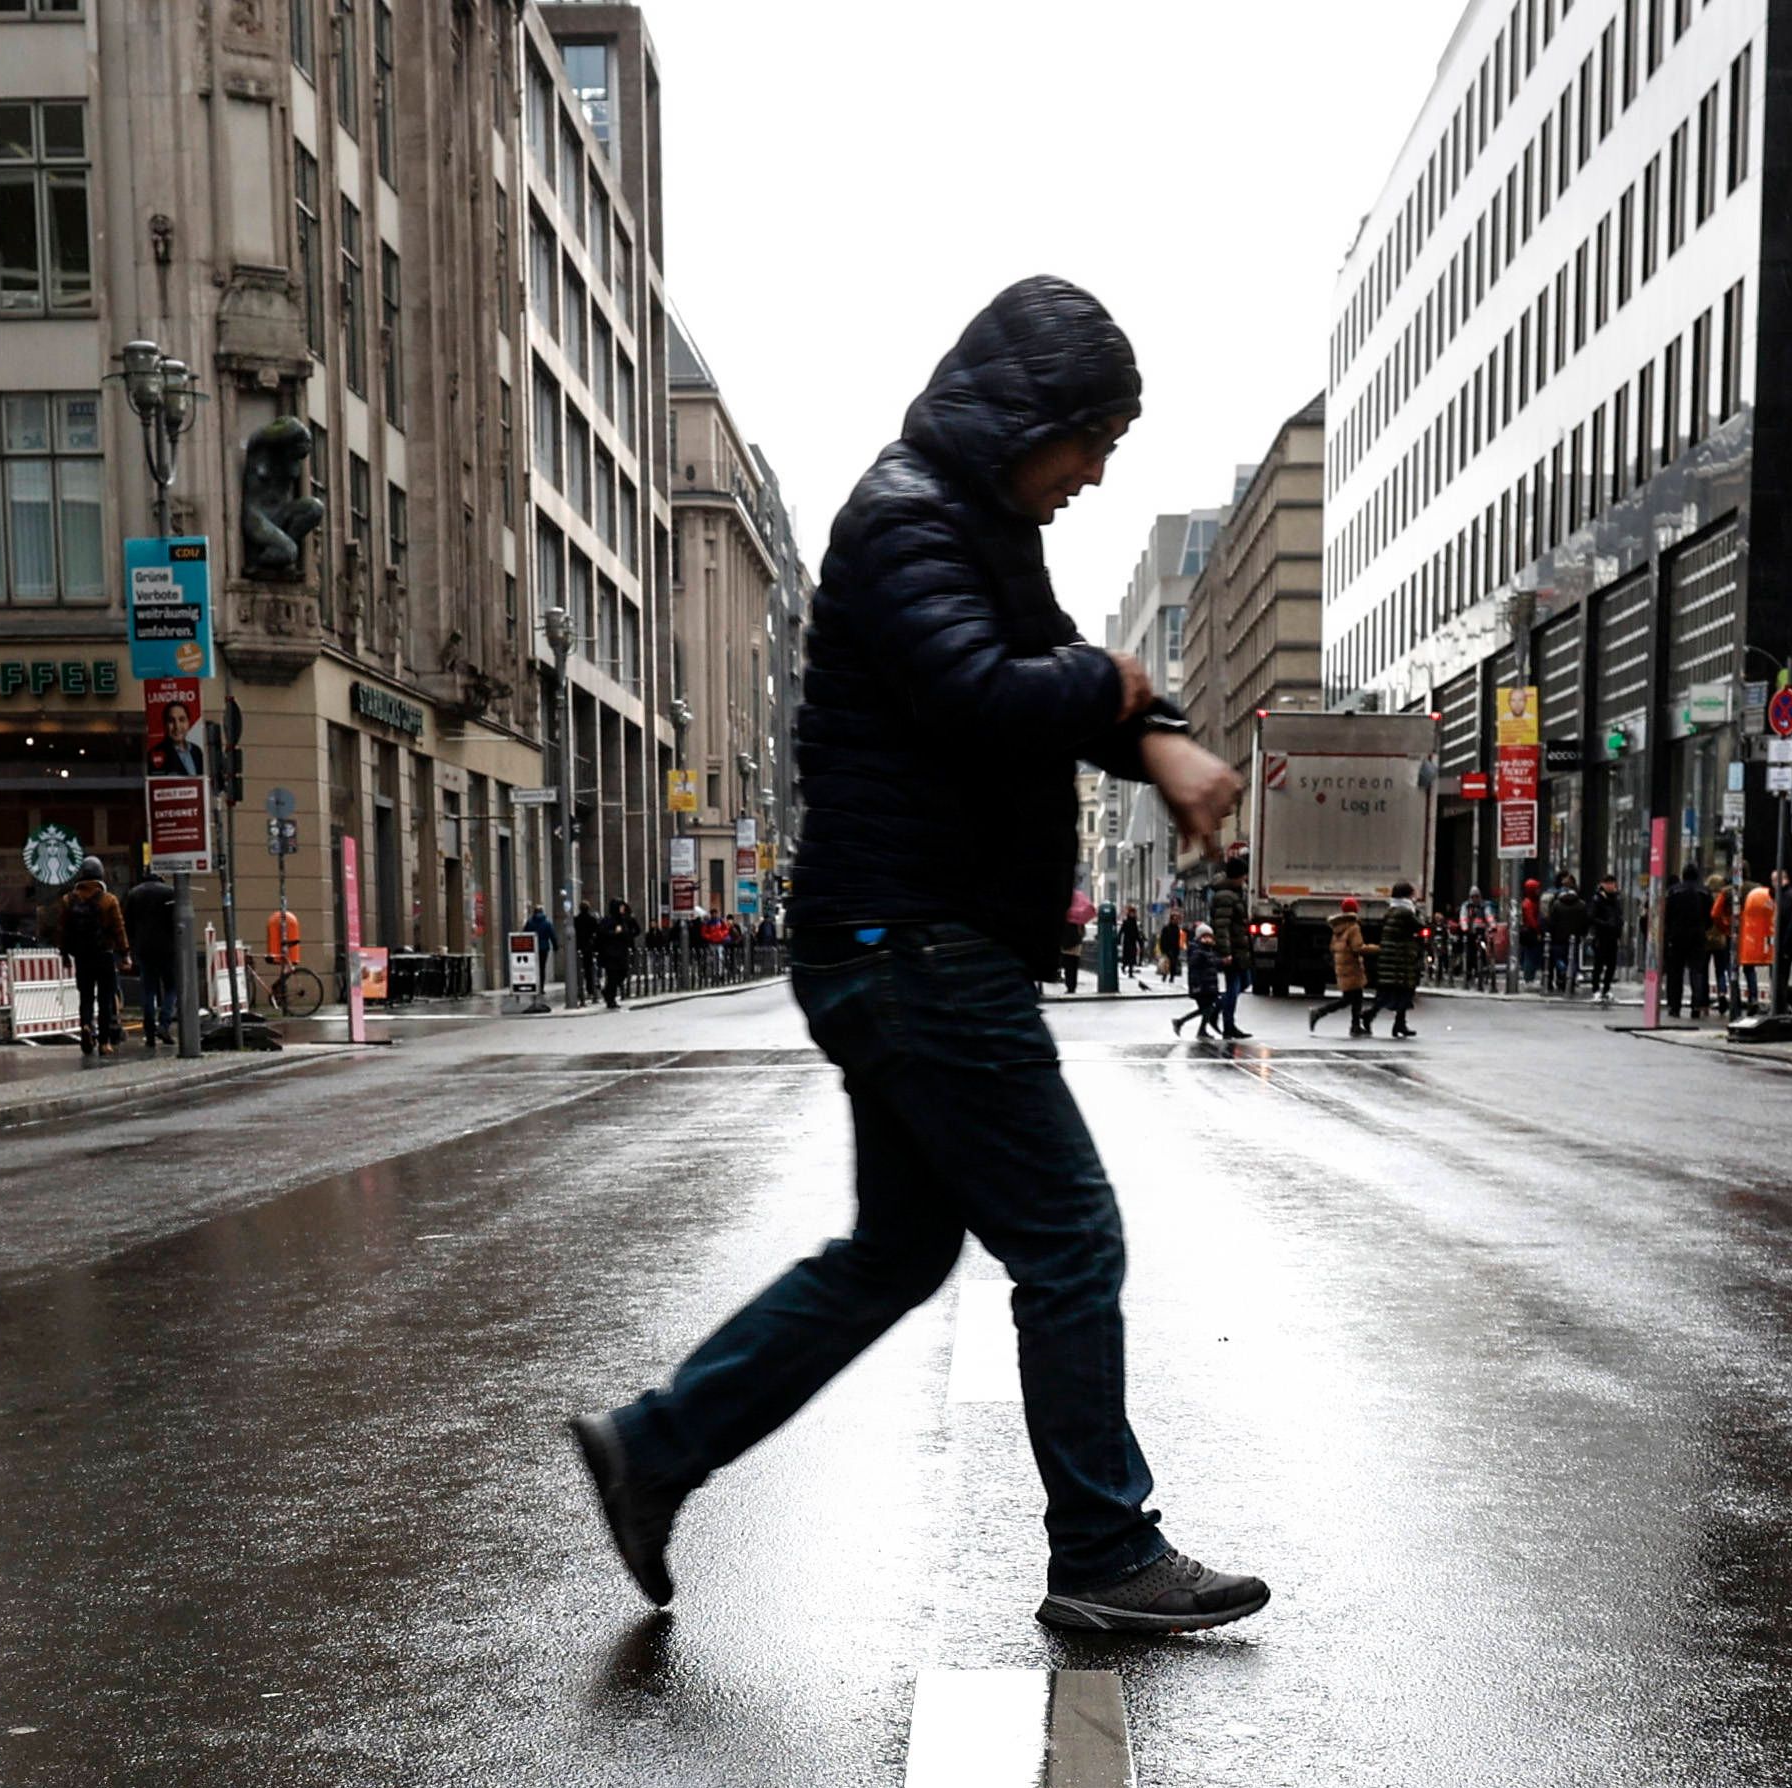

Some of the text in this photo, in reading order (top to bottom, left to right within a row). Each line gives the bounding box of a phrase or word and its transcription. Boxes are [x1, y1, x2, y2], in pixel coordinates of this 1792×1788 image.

[134, 571, 169, 583] Grüne
[135, 589, 179, 601] Verbote
[136, 606, 201, 621] weiträumig
[137, 624, 194, 638] umfahren.
[147, 690, 196, 704] LANDERO
[1300, 775, 1394, 792] syncreon
[1341, 798, 1386, 816] Log it
